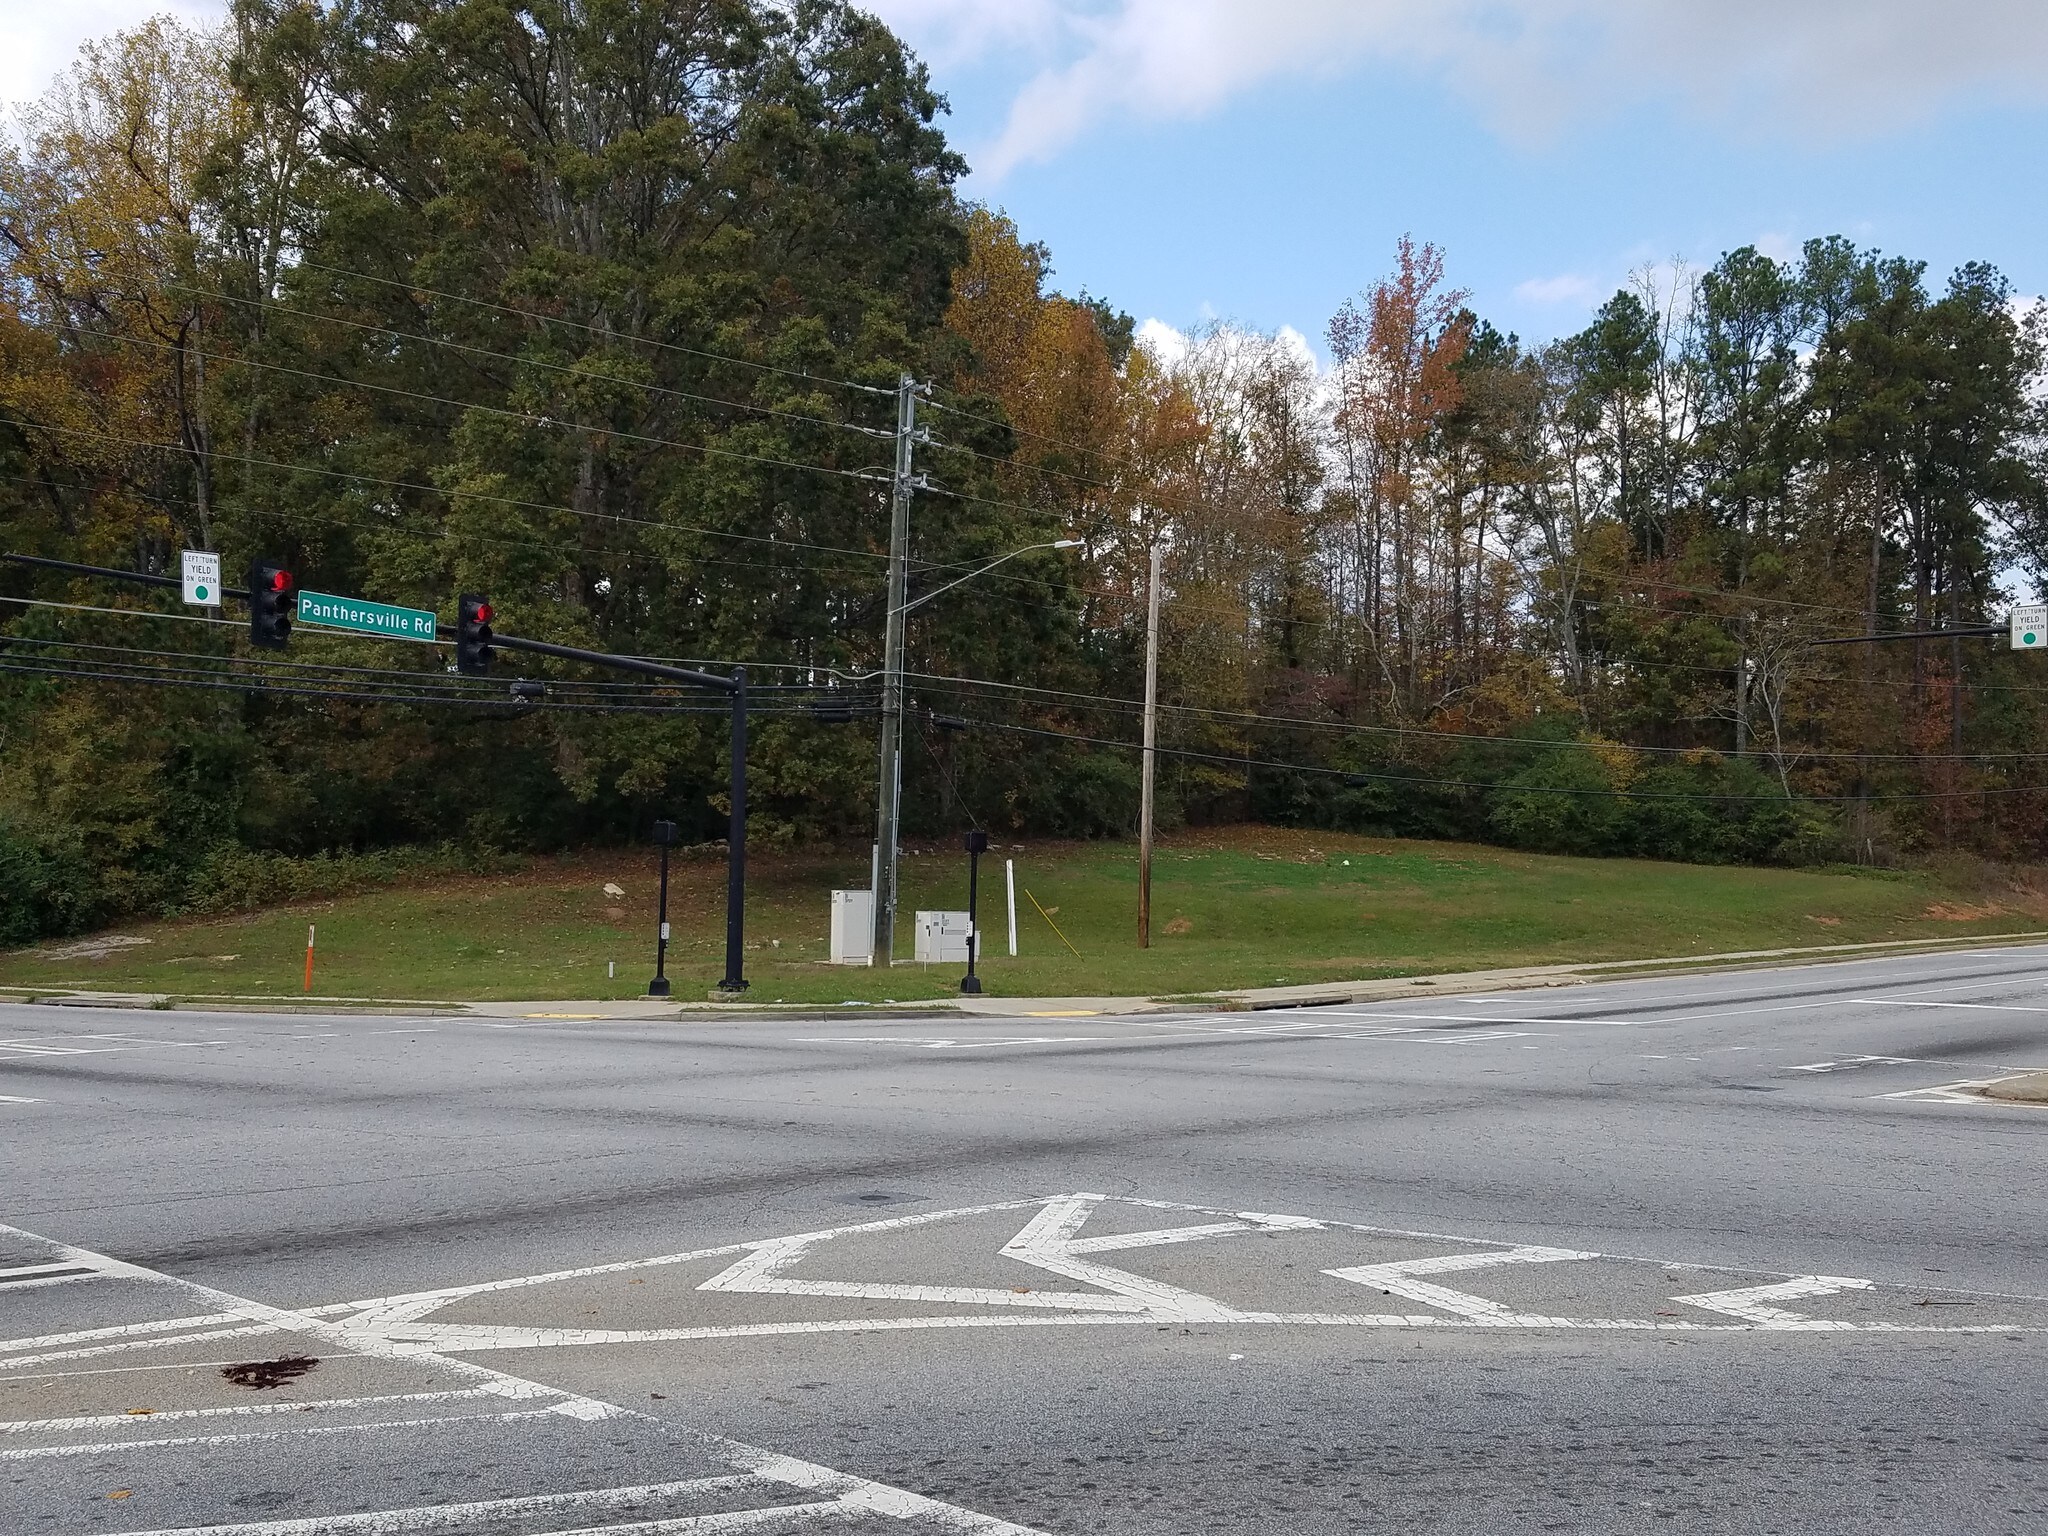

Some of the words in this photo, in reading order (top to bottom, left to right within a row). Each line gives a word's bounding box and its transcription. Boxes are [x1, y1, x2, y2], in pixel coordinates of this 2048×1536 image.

[200, 556, 218, 564] TURN
[191, 565, 212, 575] YIELD
[198, 575, 217, 584] GREEN
[302, 599, 408, 630] Panthersville
[414, 617, 432, 634] Rd
[2019, 615, 2040, 624] YIELD
